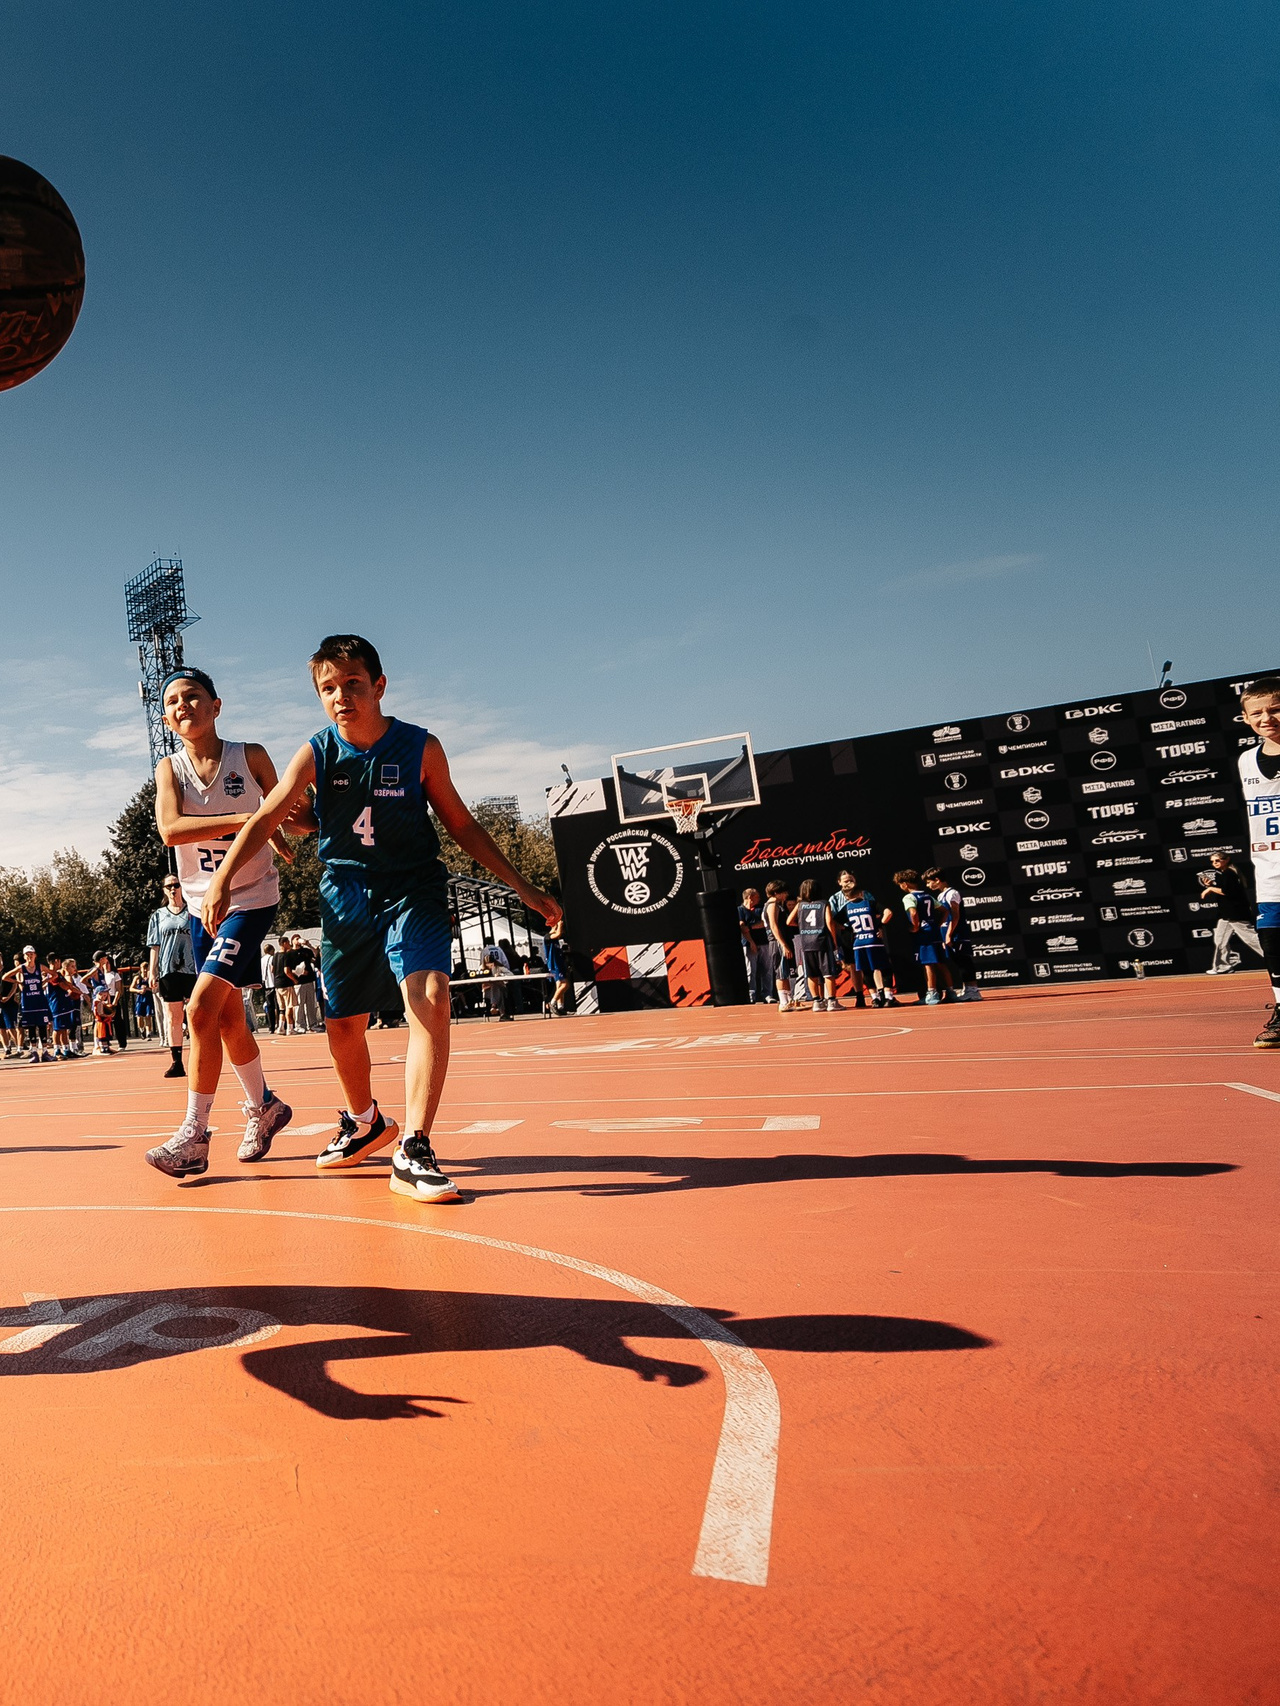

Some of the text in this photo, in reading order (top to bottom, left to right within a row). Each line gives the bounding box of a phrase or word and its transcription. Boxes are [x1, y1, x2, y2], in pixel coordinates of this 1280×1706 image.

[1163, 695, 1184, 703] РФБ
[1084, 703, 1122, 716] DKC
[1176, 718, 1206, 727] RATINGS
[1008, 741, 1047, 750] ЧЕМПИОНАТ
[1019, 764, 1055, 776] DKC
[1106, 780, 1135, 788] RATINGS
[1160, 771, 1219, 786] СПОРТ
[373, 788, 405, 797] ОЗЁРНЫЙ
[946, 799, 983, 808] ЧЕМПИОНАТ
[352, 806, 375, 846] 4
[956, 822, 990, 833] DKC
[1039, 839, 1067, 849] RATINGS
[1091, 833, 1148, 845] СПОРТ
[740, 829, 870, 864] Баскетбол
[590, 842, 607, 862] ПРОЕКТ
[606, 829, 650, 843] РОССИЙСКОЙ
[651, 833, 680, 861] ФЕДЕРАЦИИ
[667, 862, 684, 898] БАСКЕТБОЛА
[734, 847, 873, 871] самый доступный спорт
[975, 896, 1002, 905] RATINGS
[1029, 890, 1083, 902] СПОРТ
[805, 909, 817, 927] 4
[849, 914, 875, 932] 20
[208, 937, 241, 966] 22
[973, 947, 1014, 957] ПОРТ
